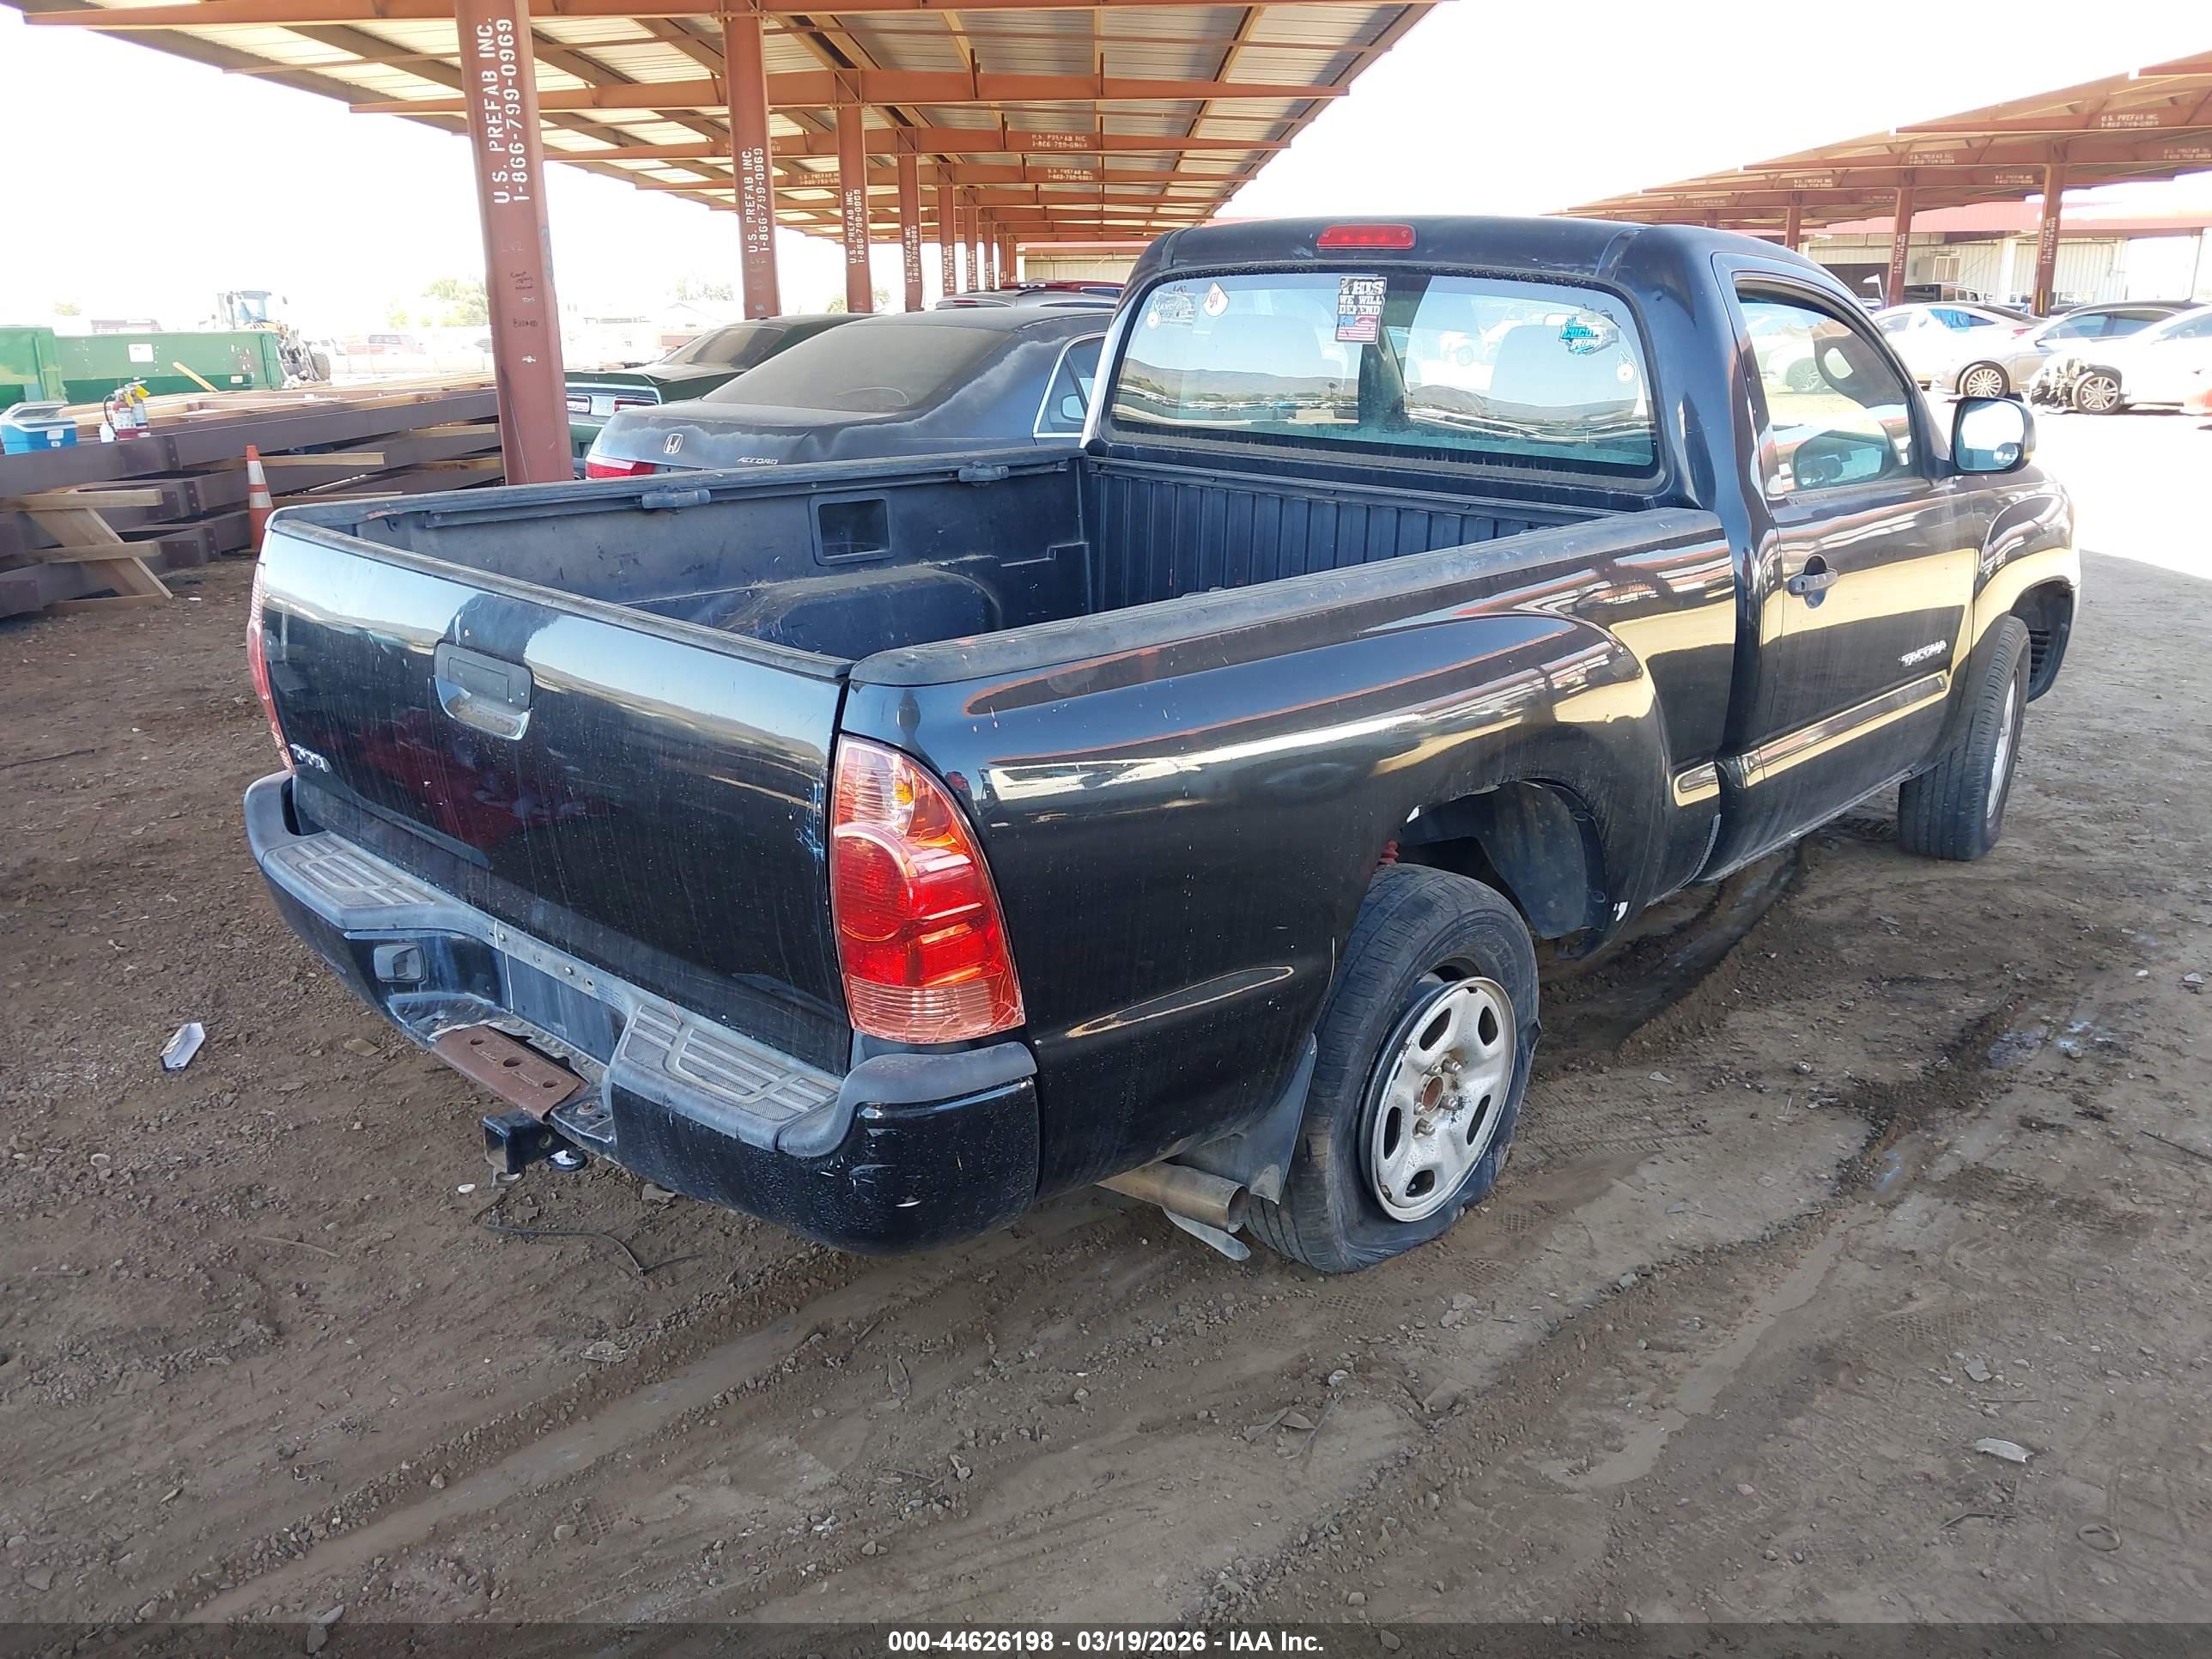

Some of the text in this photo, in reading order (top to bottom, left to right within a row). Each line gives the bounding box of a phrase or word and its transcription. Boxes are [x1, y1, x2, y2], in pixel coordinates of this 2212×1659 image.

[477, 17, 510, 204] U.S. PREFAB INC.
[495, 18, 530, 202] 1-866-799-0969
[742, 147, 753, 170] INC.
[744, 176, 757, 223] PREFAB
[753, 147, 770, 252] 1-866-799-0969
[748, 229, 759, 252] U.S.
[847, 209, 855, 243] PREFAB
[1338, 304, 1381, 315] DEFEND
[1339, 295, 1382, 305] WE WILL
